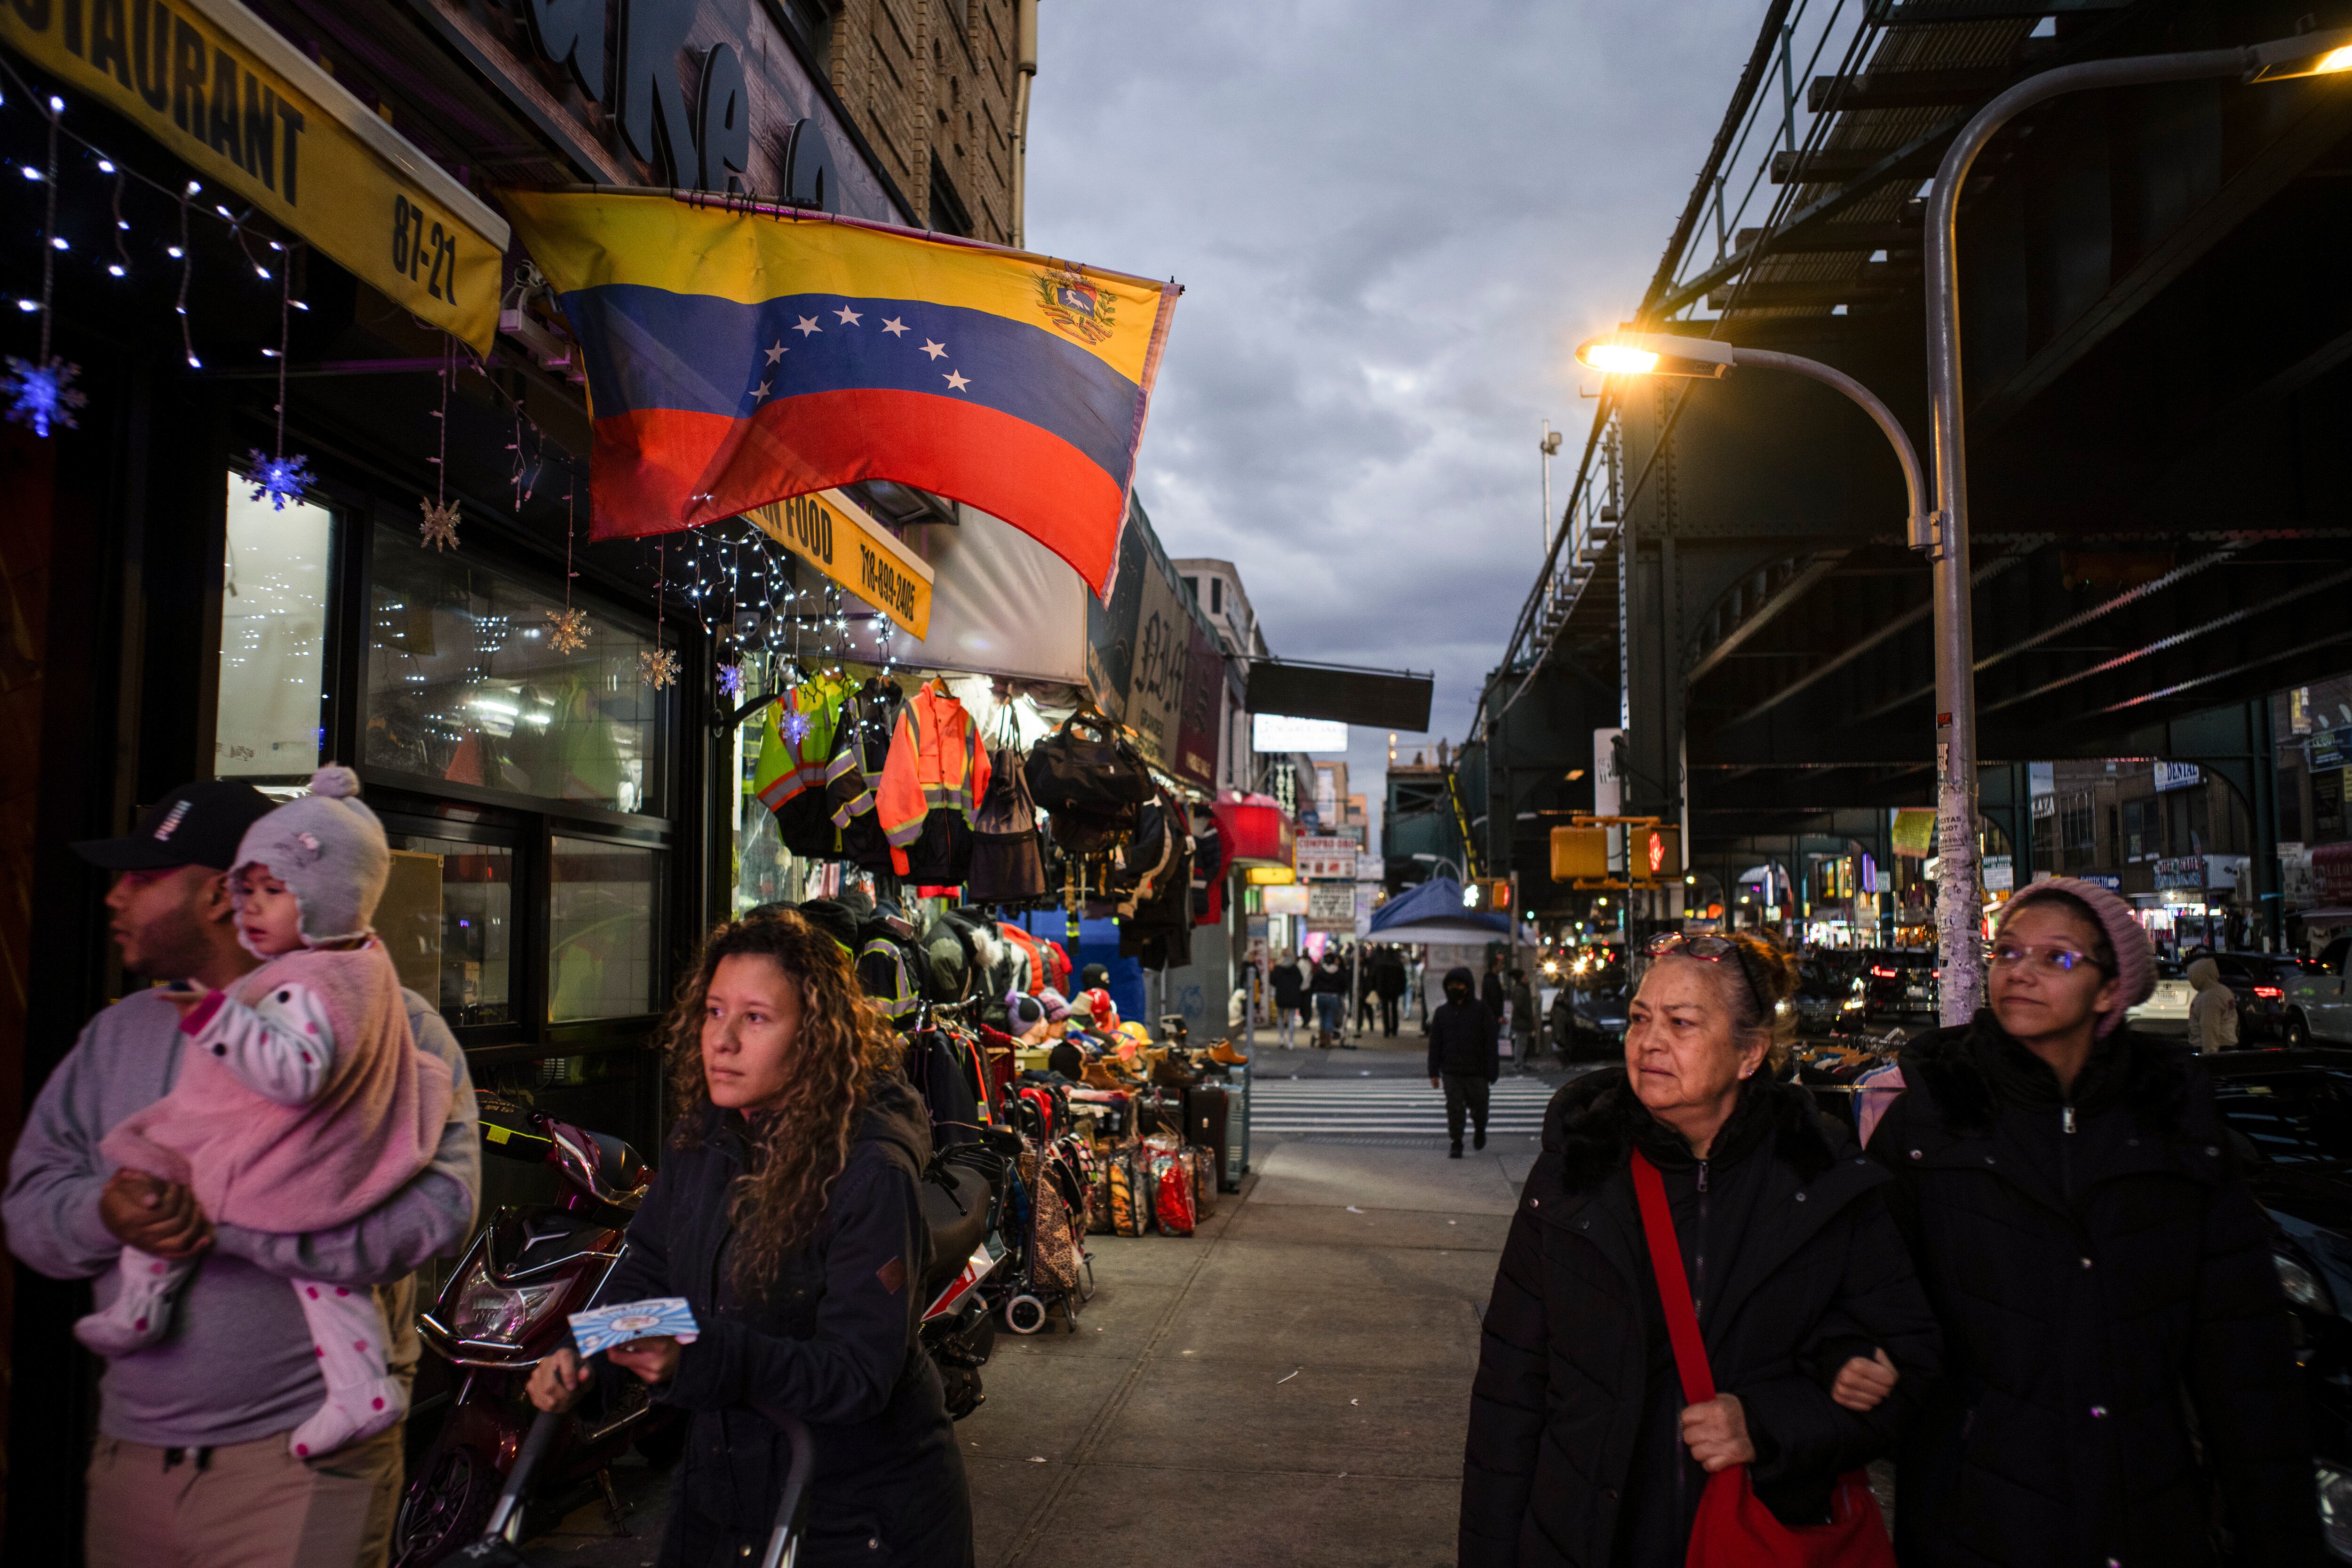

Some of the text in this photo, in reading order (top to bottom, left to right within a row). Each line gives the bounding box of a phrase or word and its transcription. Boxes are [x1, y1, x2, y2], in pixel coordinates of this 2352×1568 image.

[10, 0, 304, 207] TAURANT
[393, 194, 457, 306] 87-21
[785, 494, 833, 565] FOOD
[860, 543, 915, 622] 718-899-2405
[2167, 761, 2197, 781] DENTAL
